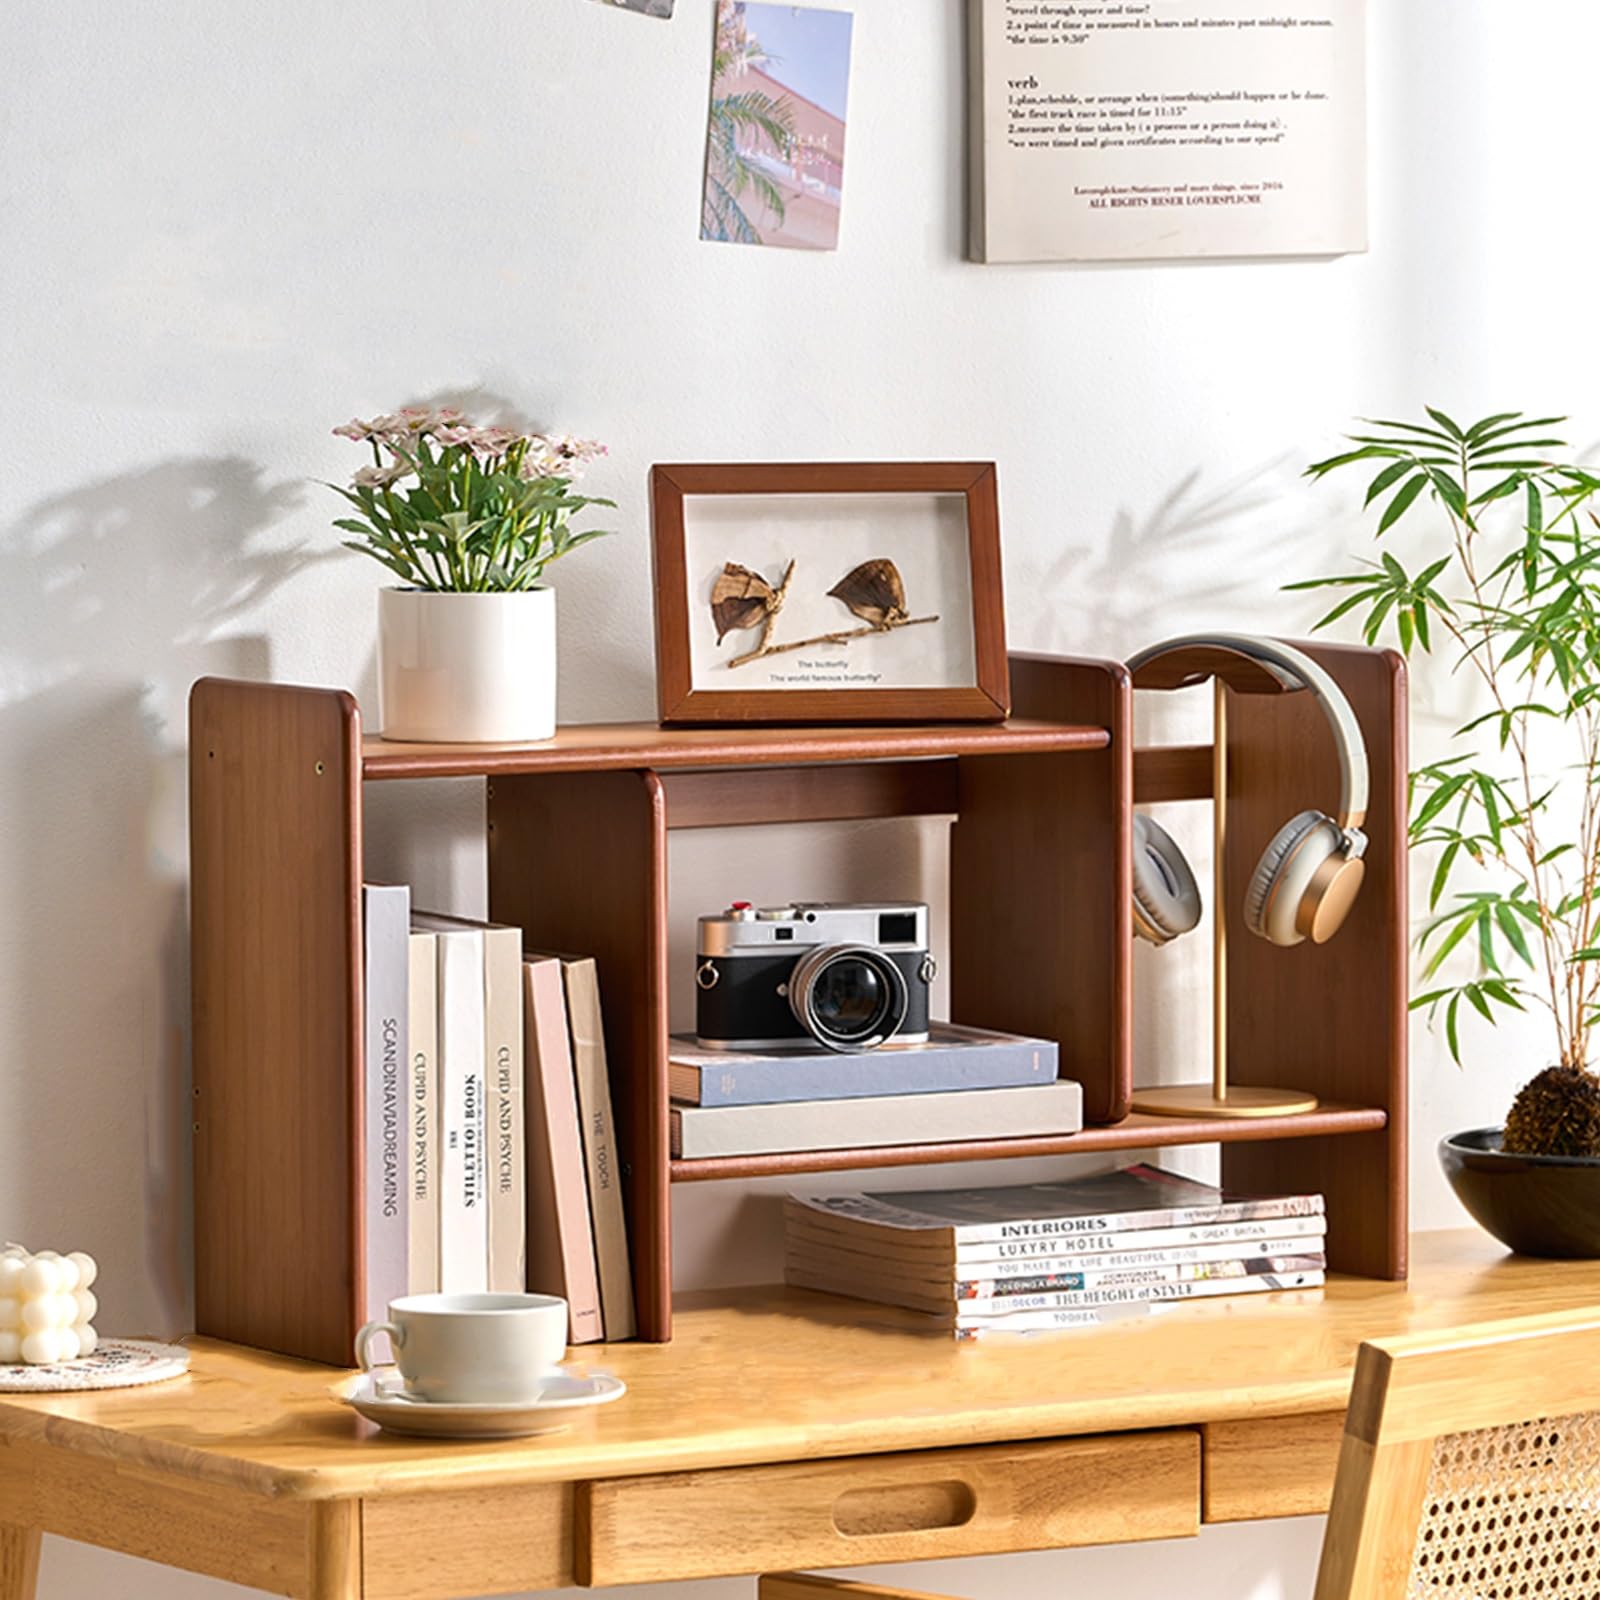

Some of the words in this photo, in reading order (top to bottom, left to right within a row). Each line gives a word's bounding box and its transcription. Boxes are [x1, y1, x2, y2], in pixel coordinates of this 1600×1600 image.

[1040, 5, 1076, 17] through
[1107, 5, 1122, 15] and
[1024, 20, 1048, 31] point
[1050, 20, 1061, 30] of
[1062, 20, 1082, 30] time
[1085, 21, 1095, 29] as
[1097, 19, 1140, 29] measured
[1143, 19, 1151, 28] in
[1154, 18, 1179, 28] hours
[1182, 18, 1198, 28] and
[1201, 18, 1236, 28] minutes
[1238, 18, 1256, 29] past
[1259, 17, 1297, 28] midnight
[1029, 34, 1049, 44] time
[1052, 34, 1059, 44] is
[1008, 75, 1038, 89] verb
[1085, 96, 1095, 104] or
[1098, 94, 1132, 105] arrange
[1136, 93, 1158, 103] when
[1244, 90, 1276, 103] happen
[1279, 92, 1288, 100] or
[1291, 90, 1301, 100] be
[1029, 108, 1048, 119] first
[1050, 107, 1074, 118] track
[1077, 110, 1097, 118] race
[1100, 108, 1107, 118] is
[1109, 107, 1135, 117] timed
[1137, 106, 1152, 117] for
[1058, 123, 1072, 133] the
[1075, 123, 1093, 133] time
[1098, 122, 1122, 132] taken
[1125, 122, 1136, 134] by
[1154, 123, 1187, 133] process
[1190, 122, 1200, 130] or
[1203, 122, 1208, 130] a
[1211, 121, 1241, 132] person
[1244, 119, 1267, 131] doing
[1029, 140, 1049, 148] were
[1052, 137, 1078, 148] timed
[1081, 137, 1097, 147] and
[1100, 137, 1124, 149] given
[1127, 135, 1176, 147] certificates
[1179, 134, 1222, 146] according
[1225, 135, 1234, 144] to
[1089, 198, 1108, 208] ALL
[1111, 197, 1149, 208] RIGHTS
[798, 660, 813, 668] The
[815, 660, 848, 669] butterfly
[770, 674, 784, 682] The
[787, 674, 810, 682] world
[811, 674, 842, 682] famous
[414, 1052, 426, 1101] CUPID
[498, 1046, 510, 1094] CUPID
[464, 1074, 476, 1119] BOOK
[383, 1018, 398, 1217] SCANDINAVIADREAMING
[415, 1105, 427, 1138] AND
[500, 1098, 511, 1131] AND
[594, 1112, 604, 1137] THE
[415, 1142, 428, 1201] PSYCHE
[464, 1128, 476, 1208] STILETTO
[500, 1134, 513, 1194] PSYCHE
[598, 1145, 610, 1190] TOUCH
[1001, 1218, 1108, 1238] INTERIORES
[1201, 1228, 1230, 1240] GREAT
[1066, 1236, 1115, 1251] HOTEL
[998, 1263, 1019, 1274] YOU
[1023, 1261, 1051, 1274] MAKE
[1058, 1259, 1073, 1270] MY
[1080, 1256, 1102, 1269] LIFE
[1055, 1293, 1082, 1306] THE
[1084, 1289, 1135, 1303] HEIGHT
[1138, 1287, 1150, 1299] of
[1153, 1284, 1193, 1298] STYLE
